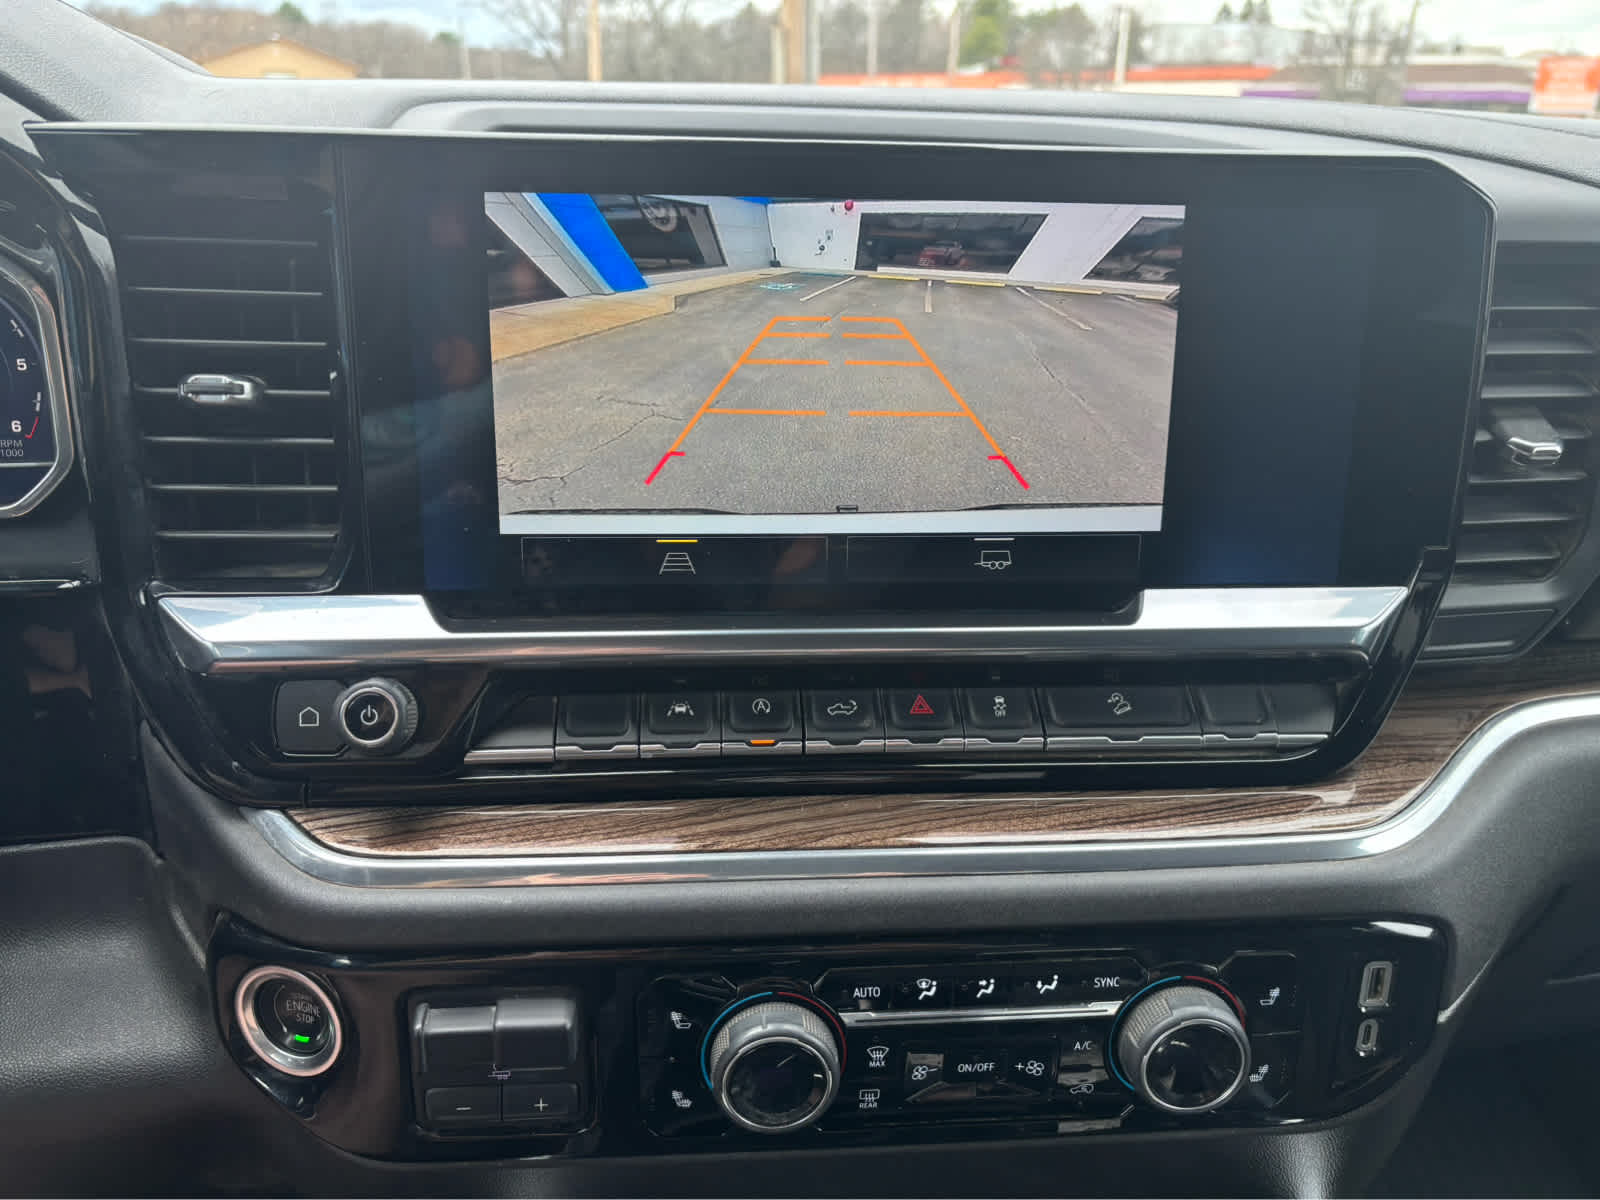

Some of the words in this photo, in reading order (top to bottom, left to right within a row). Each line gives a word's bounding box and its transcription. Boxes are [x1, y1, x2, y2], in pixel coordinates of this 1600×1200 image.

[16, 358, 27, 371] 5
[11, 420, 22, 433] 6
[1093, 977, 1121, 989] SYNC
[853, 986, 881, 998] AUTO
[286, 1000, 321, 1017] ENGINE
[296, 1012, 315, 1024] STOP
[1074, 1040, 1092, 1050] A/C
[869, 1060, 886, 1068] MAX
[957, 1062, 996, 1073] ON/OFF
